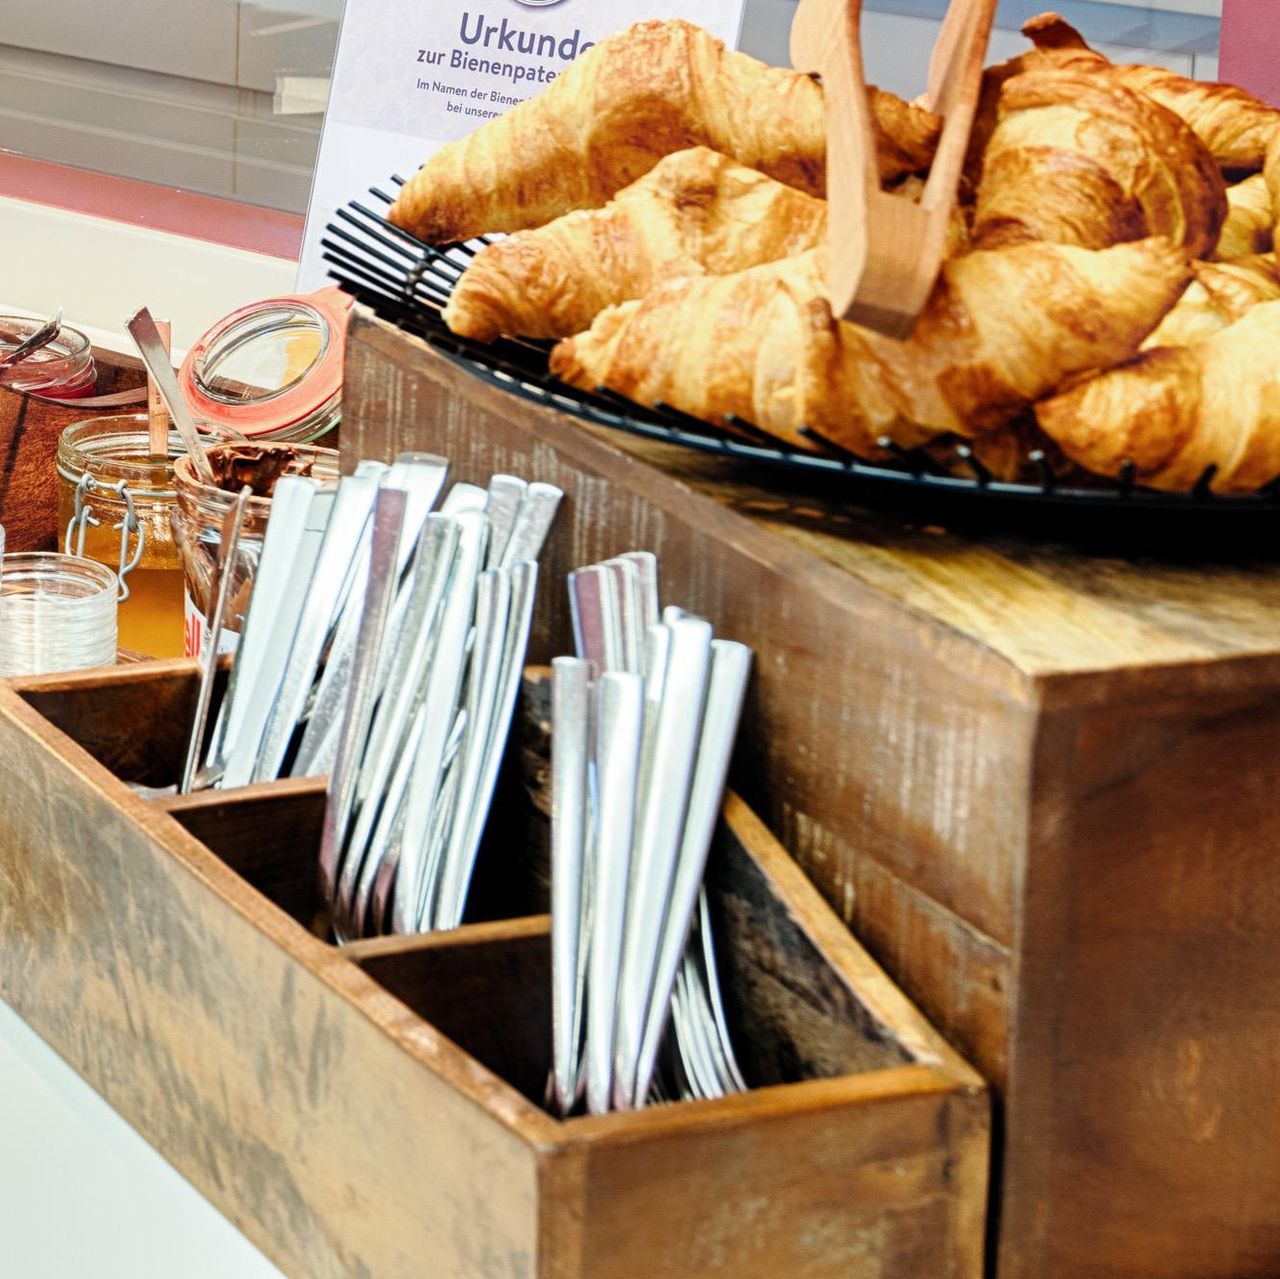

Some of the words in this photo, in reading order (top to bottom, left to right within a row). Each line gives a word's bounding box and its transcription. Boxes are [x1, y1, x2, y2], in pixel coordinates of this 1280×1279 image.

[416, 48, 446, 66] zur
[449, 49, 561, 84] Bienenpate
[416, 78, 430, 91] Im
[432, 80, 468, 98] Namen
[470, 87, 489, 100] der
[446, 100, 463, 114] bei
[465, 107, 504, 119] unsere
